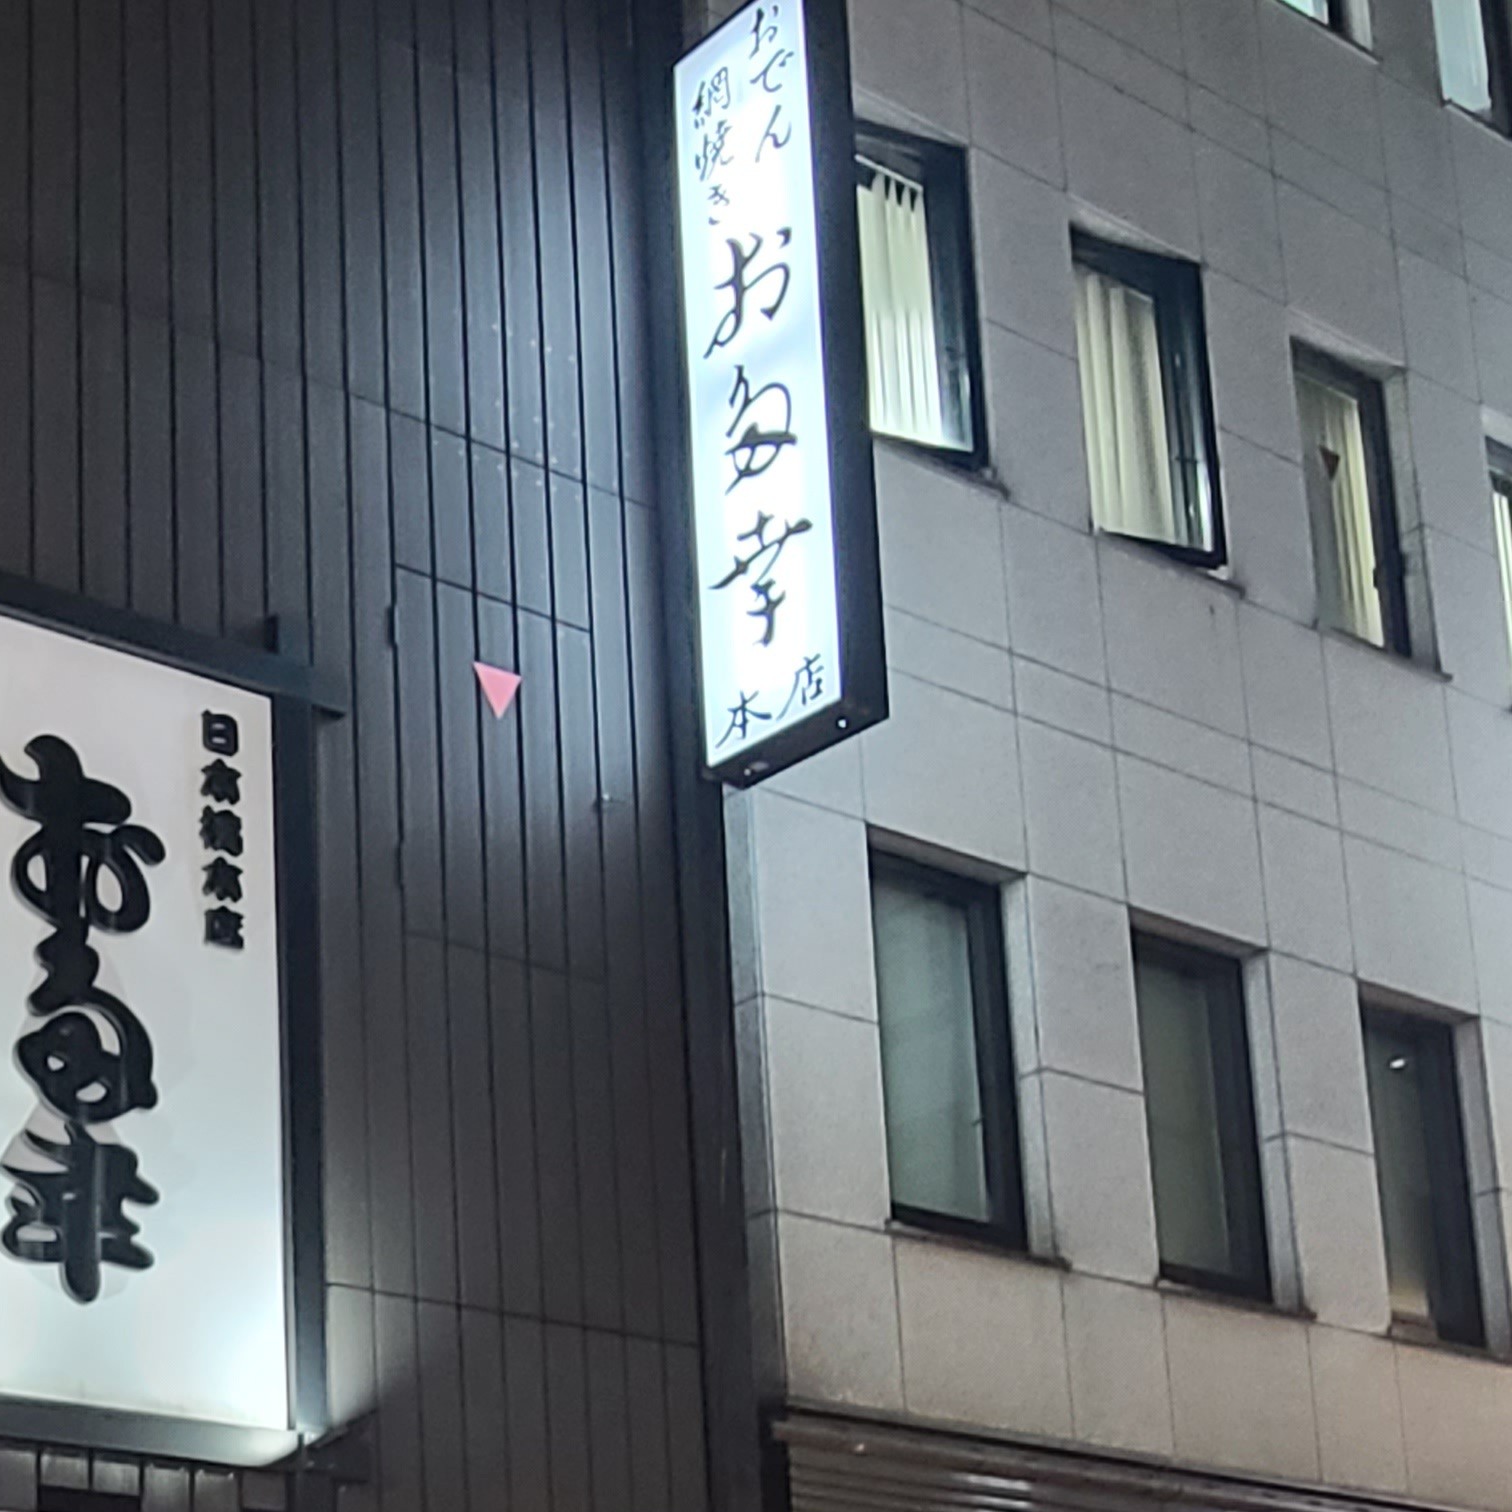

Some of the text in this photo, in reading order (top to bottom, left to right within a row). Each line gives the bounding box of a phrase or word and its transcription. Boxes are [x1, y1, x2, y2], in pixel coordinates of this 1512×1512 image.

[691, 66, 734, 226] 網焼き
[749, 5, 794, 163] おでん
[703, 228, 813, 646] お多幸
[715, 653, 827, 748] 本店
